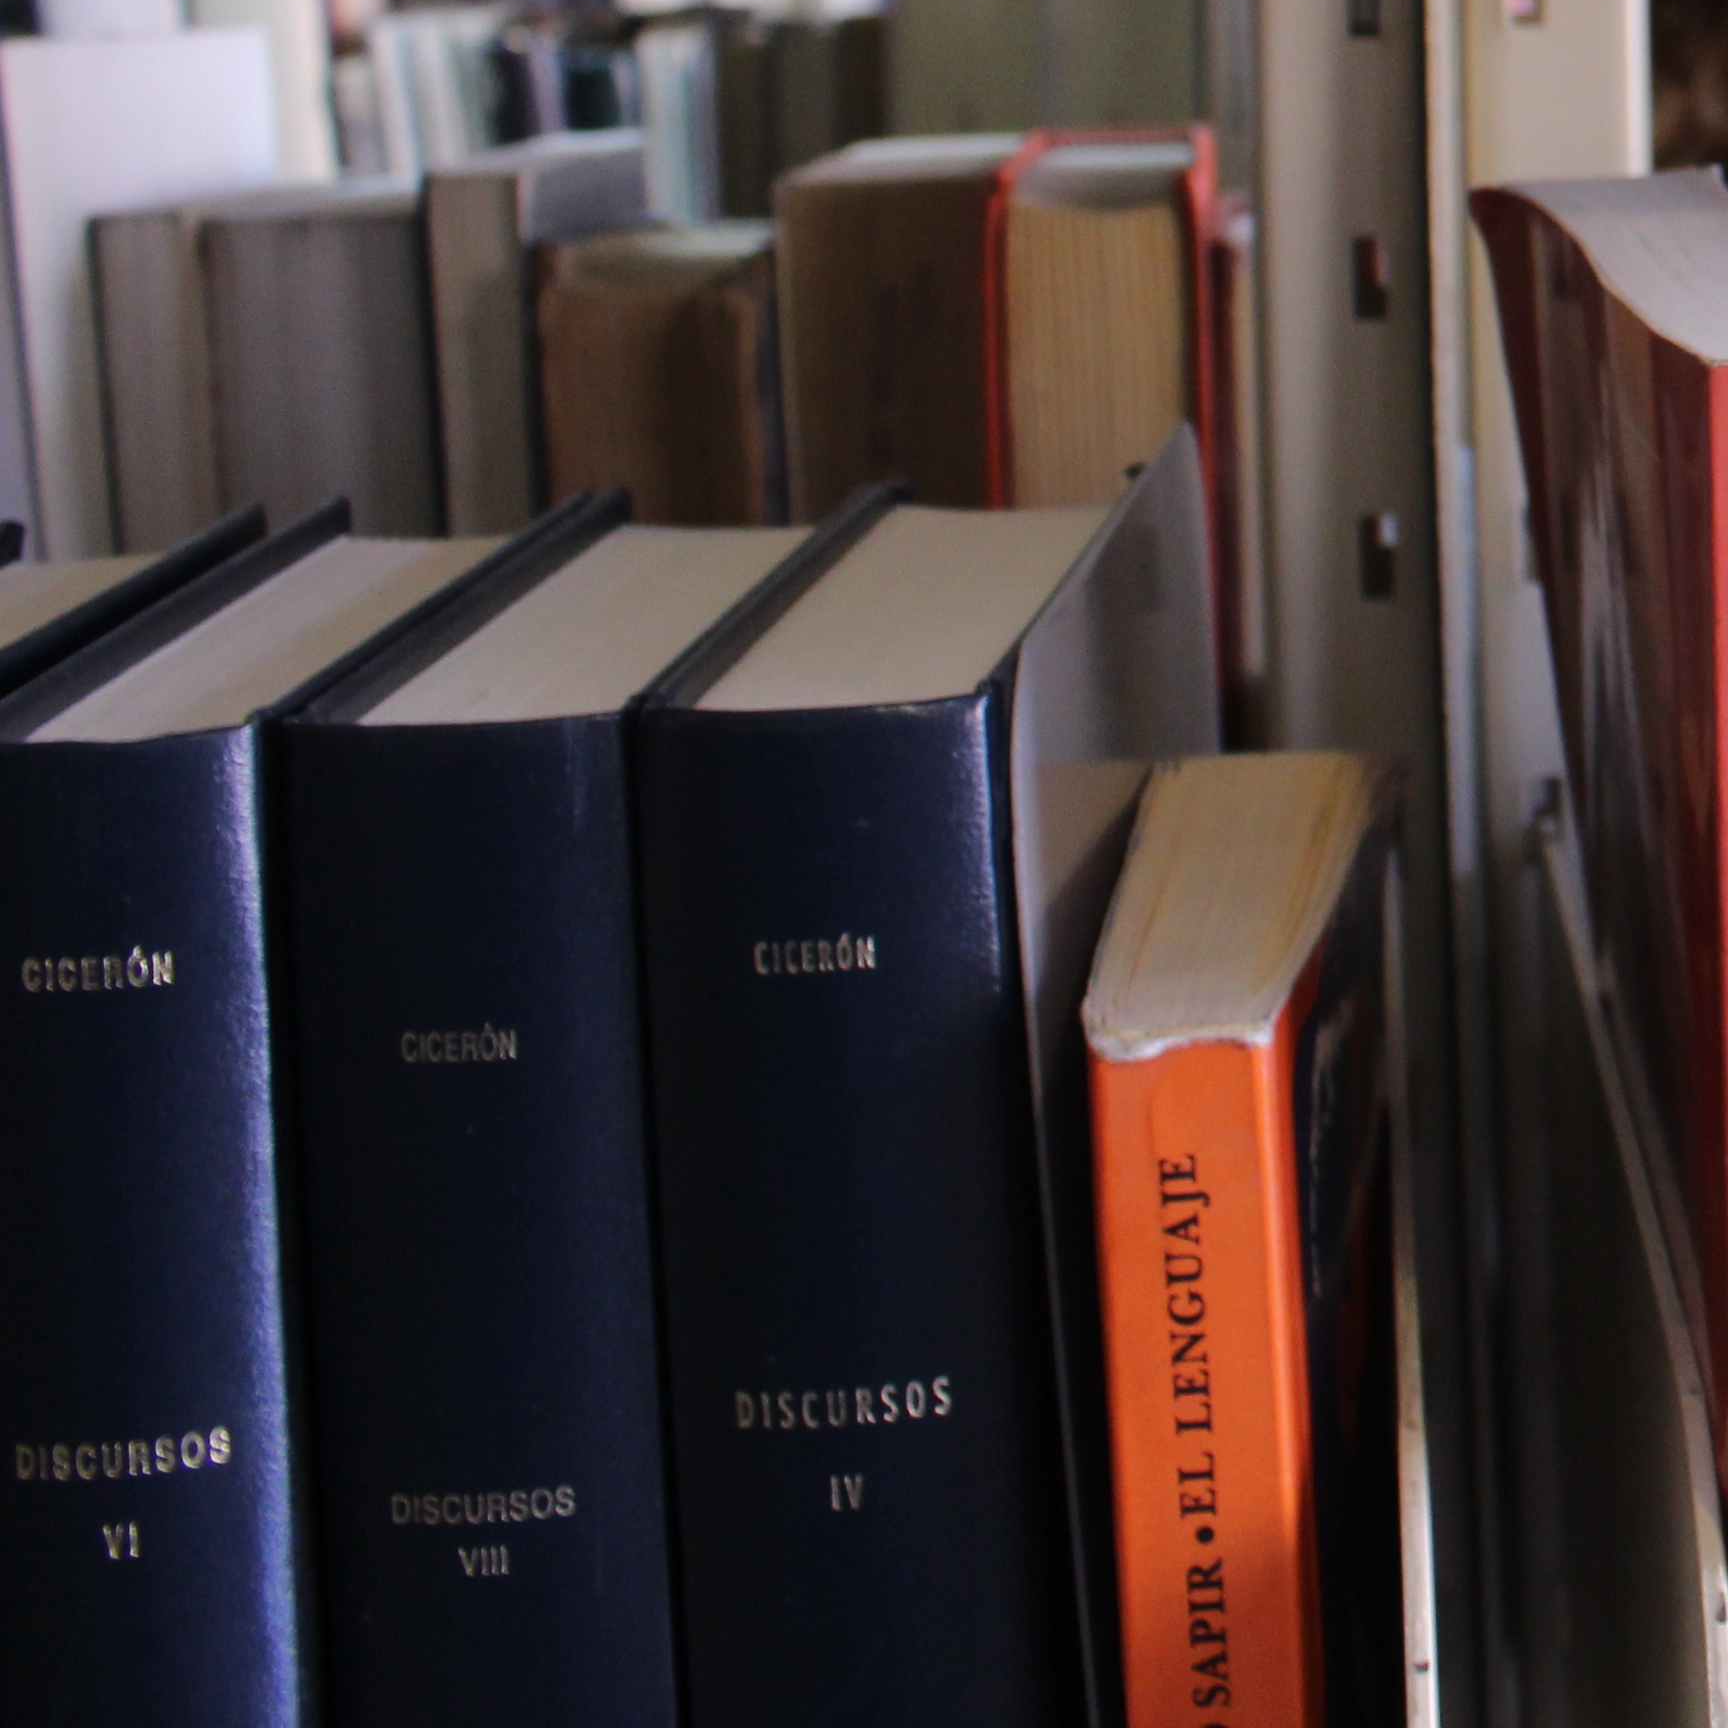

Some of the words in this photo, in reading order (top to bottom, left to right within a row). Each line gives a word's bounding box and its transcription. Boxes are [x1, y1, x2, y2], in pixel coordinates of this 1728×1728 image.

[20, 944, 175, 993] CICERÓN
[753, 932, 877, 976] CICERÓN
[400, 1023, 518, 1064] CICERÓN
[1157, 1152, 1214, 1435] LENGUAJE
[734, 1374, 952, 1431] DISCURSOS
[15, 1424, 233, 1482] DISCURSOS
[390, 1484, 577, 1526] DISCURSOS
[828, 1473, 865, 1513] IV
[1176, 1452, 1219, 1520] EL
[101, 1519, 142, 1561] VI
[457, 1543, 511, 1577] VIII
[1186, 1556, 1232, 1709] SAPIR
